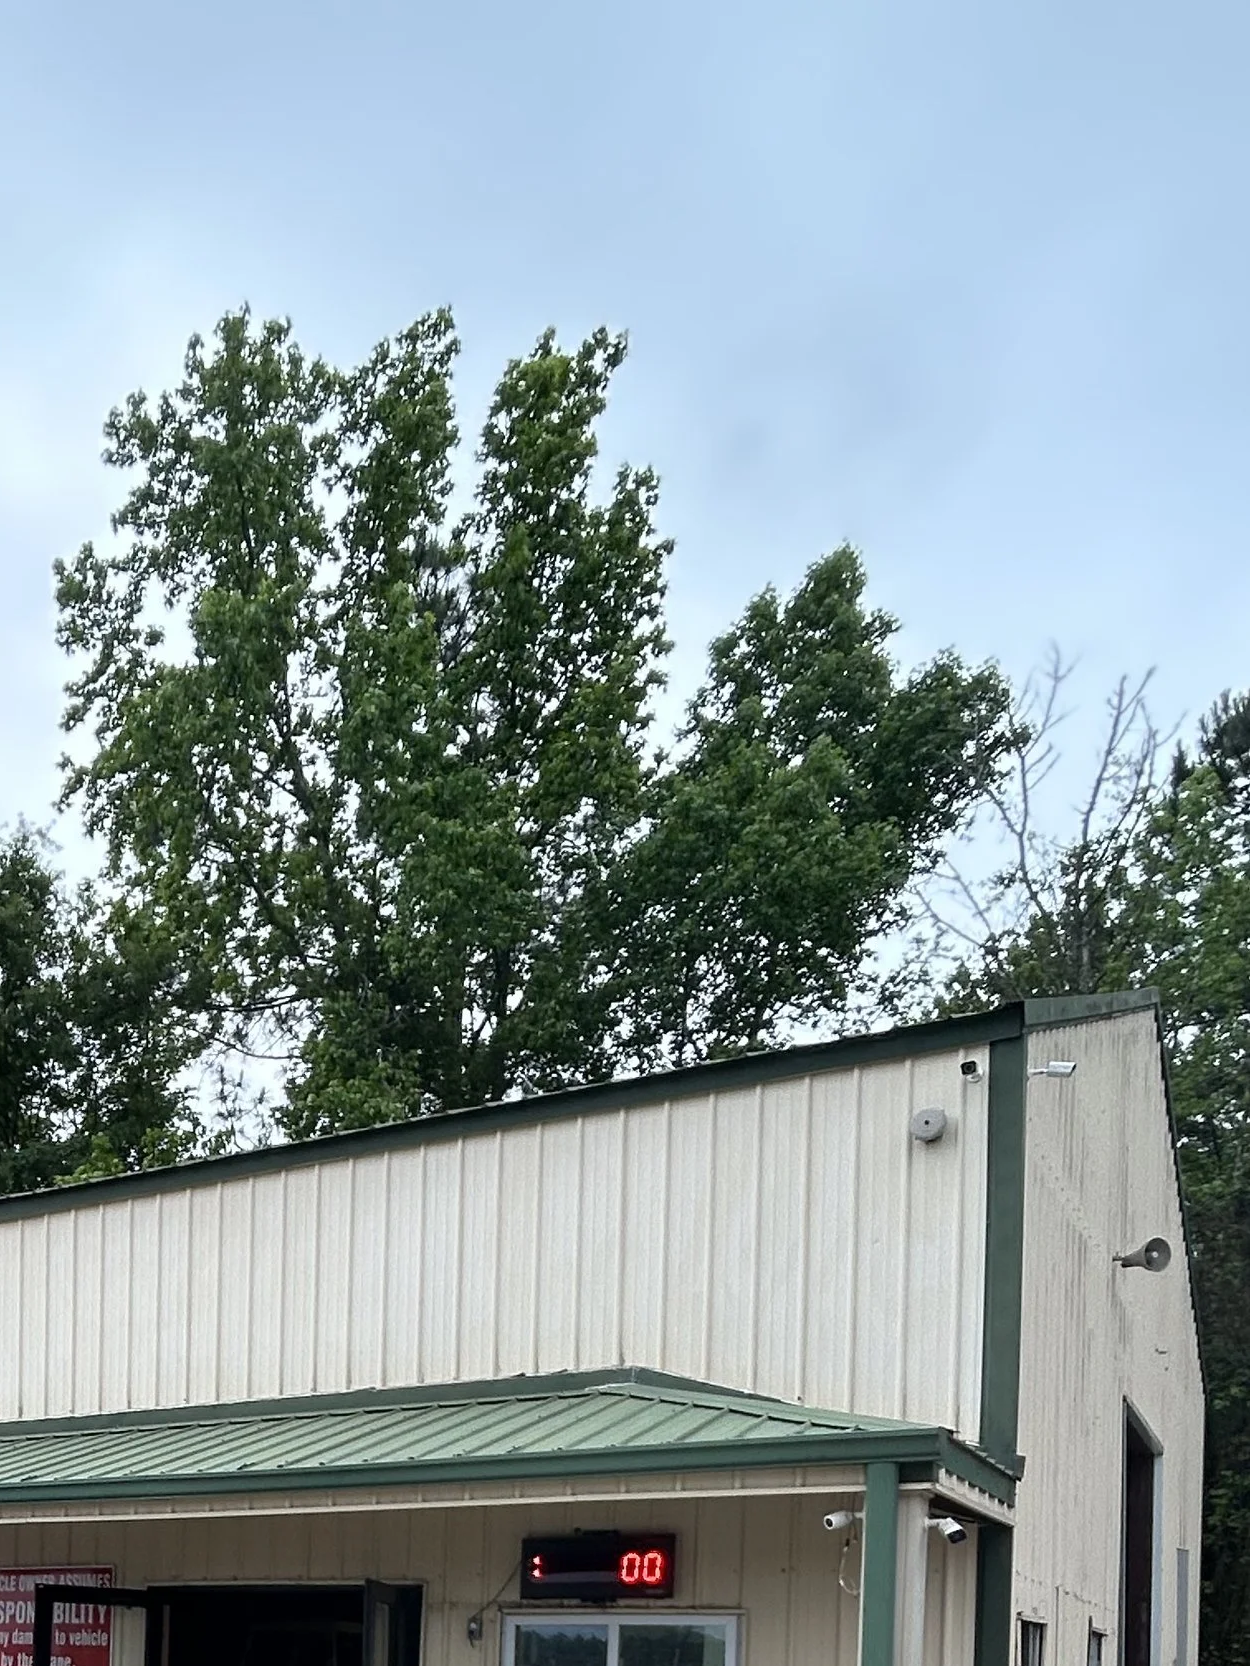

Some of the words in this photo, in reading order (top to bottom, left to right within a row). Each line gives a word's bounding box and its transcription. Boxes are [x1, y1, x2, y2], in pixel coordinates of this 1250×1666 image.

[620, 1551, 663, 1583] 00
[55, 1629, 66, 1646] to
[70, 1629, 109, 1647] vehicle
